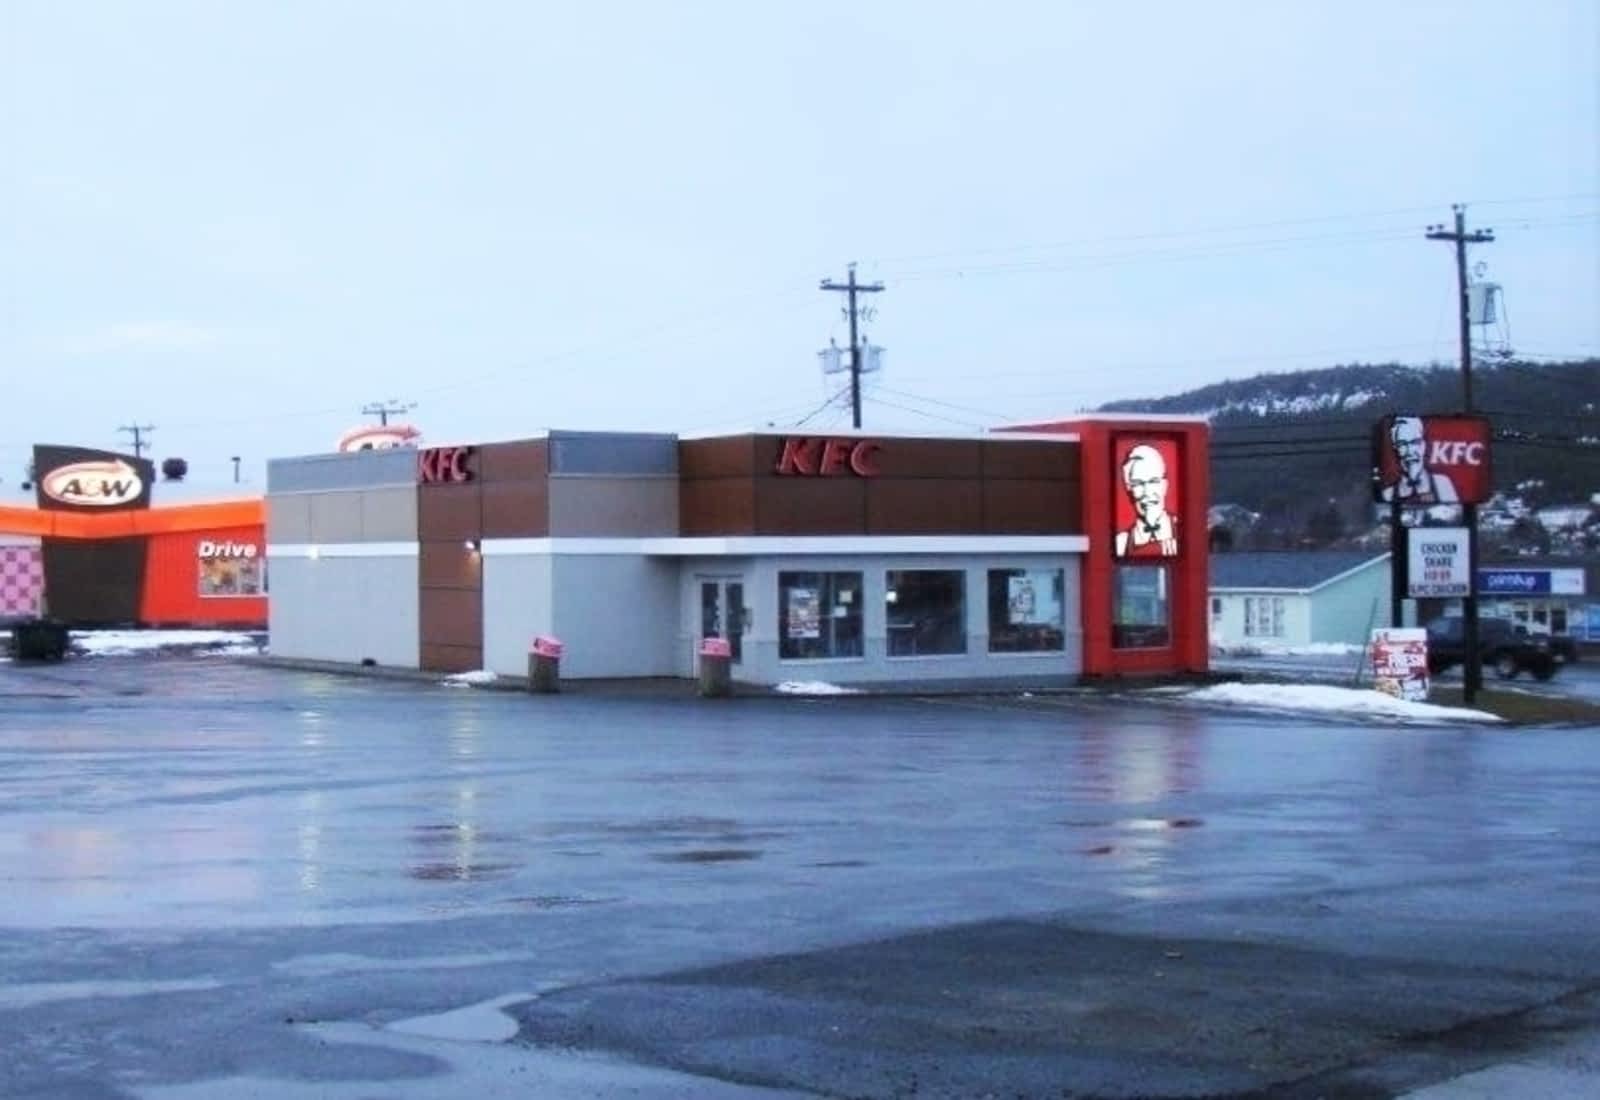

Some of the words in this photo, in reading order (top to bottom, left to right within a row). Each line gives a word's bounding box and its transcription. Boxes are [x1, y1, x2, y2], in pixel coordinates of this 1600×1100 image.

[417, 447, 469, 483] KFC
[776, 438, 882, 476] KFC
[1429, 441, 1484, 466] KFC
[60, 478, 133, 498] A&W
[198, 540, 257, 557] Drive
